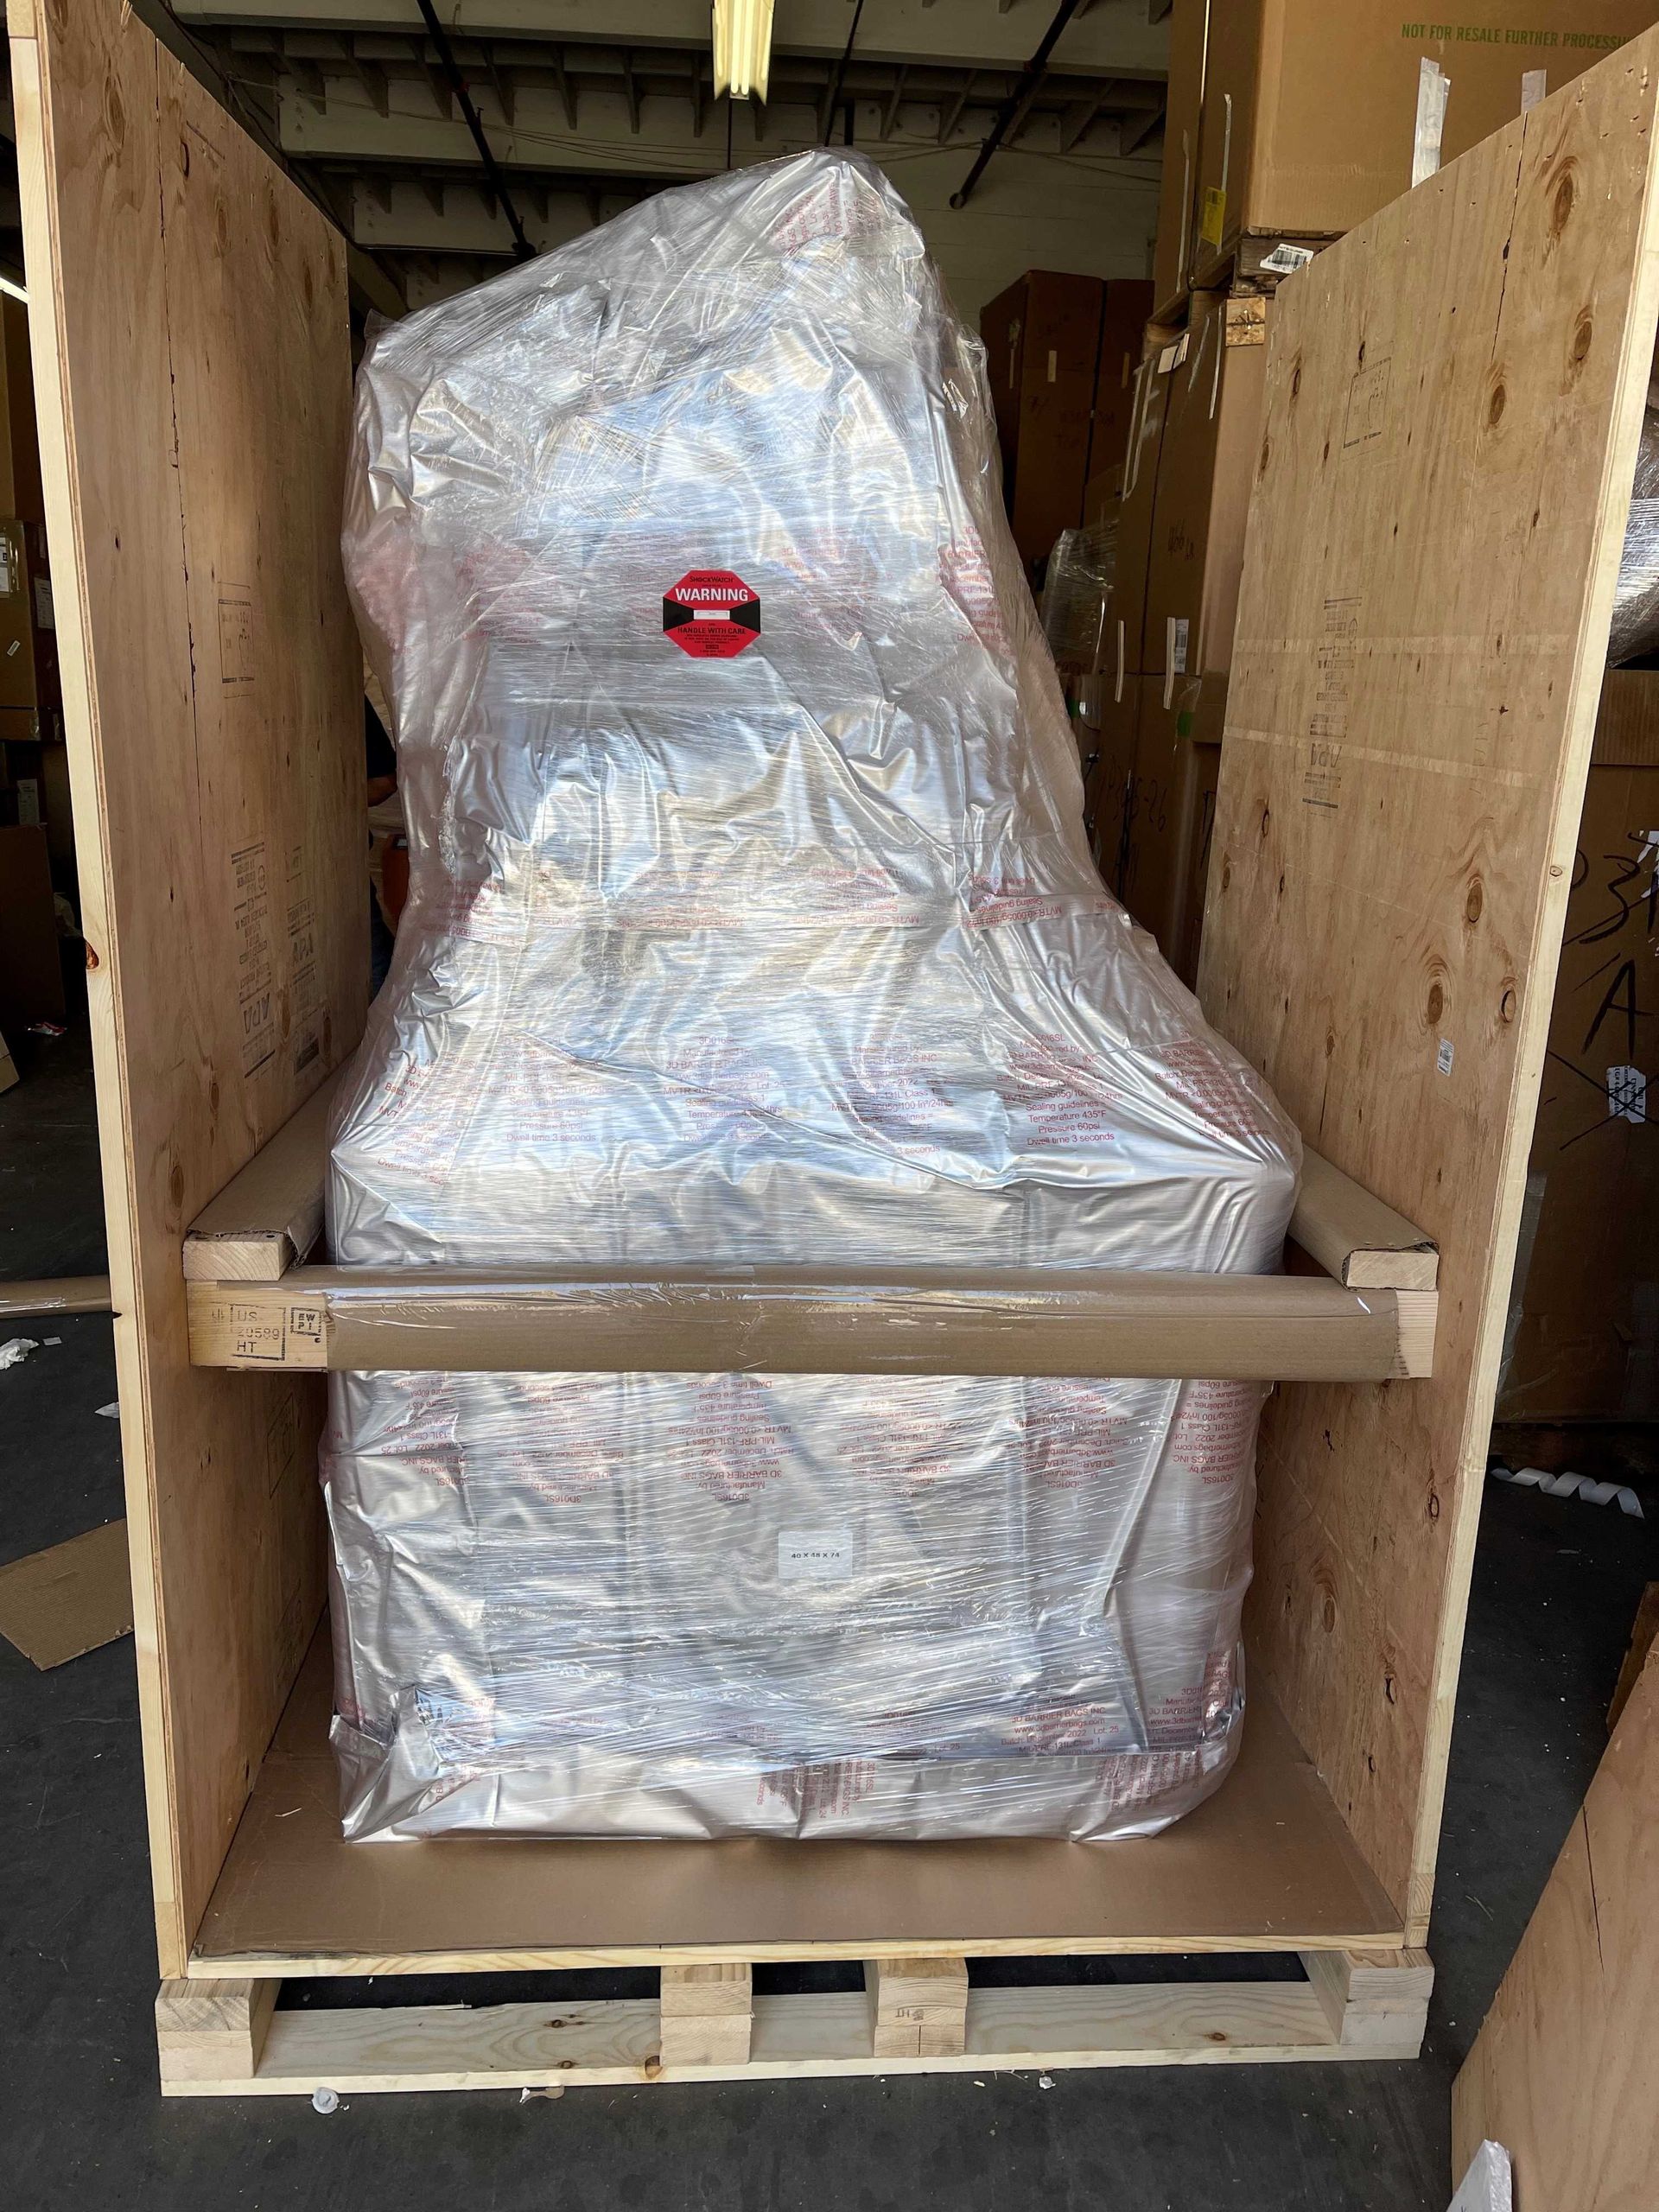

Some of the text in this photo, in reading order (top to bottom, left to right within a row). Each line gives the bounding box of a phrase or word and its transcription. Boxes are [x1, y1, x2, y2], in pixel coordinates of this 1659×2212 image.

[1402, 23, 1425, 39] NOT
[1429, 24, 1452, 41] FOR
[1456, 26, 1501, 44] RESALE
[1505, 29, 1558, 48] FURTHER
[675, 588, 748, 601] WARNING
[977, 898, 1043, 913] Sealing guidelines
[1039, 906, 1062, 918] MVTR
[1026, 1101, 1099, 1112] Sealing guidelines
[1028, 1109, 1106, 1123] Temperature 435°F
[1039, 1122, 1100, 1133] Pressure 60psi
[560, 1133, 596, 1141] seconds
[1079, 1133, 1115, 1142] seconds
[237, 1340, 257, 1353] HT
[1198, 1381, 1220, 1389] 60psi
[1194, 1401, 1233, 1410] guidelines
[415, 1443, 435, 1452] 2022
[1104, 1459, 1116, 1468] 3D
[1173, 1454, 1216, 1464] BAGS INC
[1189, 1465, 1199, 1474] by
[1025, 1713, 1062, 1722] BARRIER
[1065, 1708, 1089, 1718] BAGS
[1067, 1729, 1087, 1738] 2022
